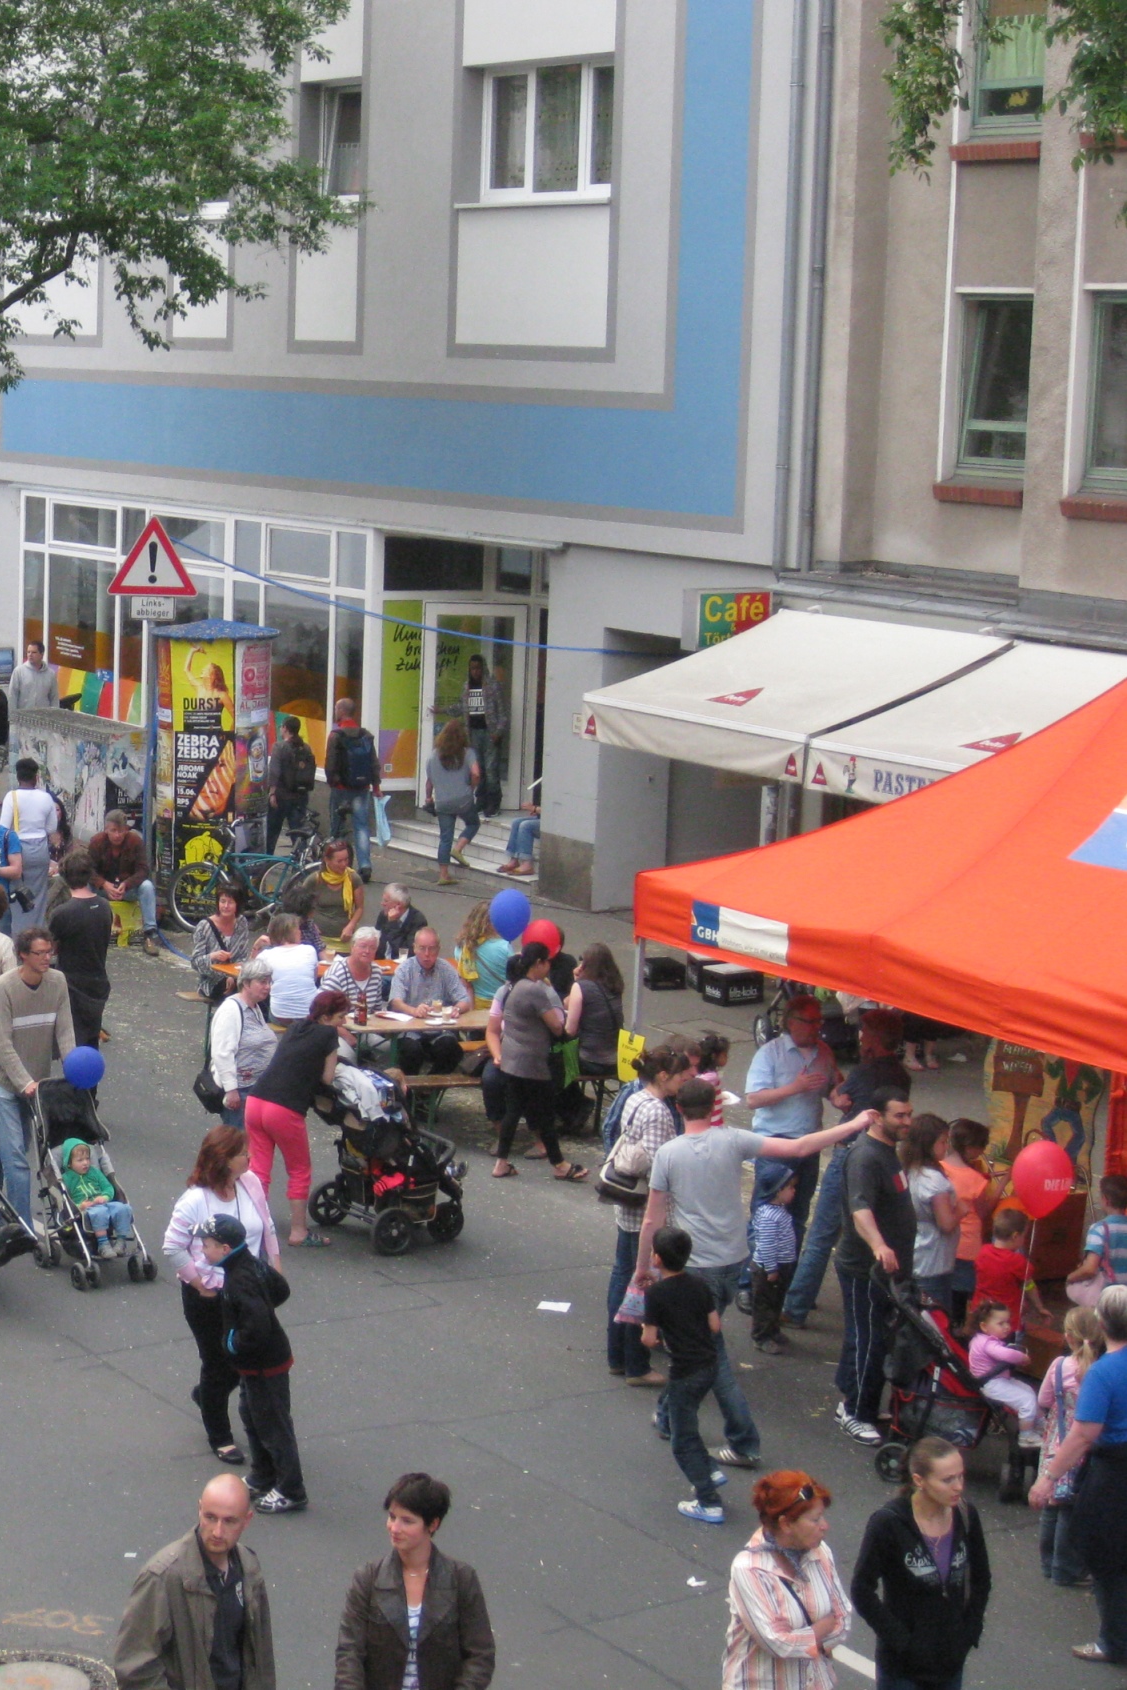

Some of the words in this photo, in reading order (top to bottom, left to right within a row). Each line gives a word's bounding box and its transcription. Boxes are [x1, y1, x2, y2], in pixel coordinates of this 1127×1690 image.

[141, 599, 165, 607] Links-
[704, 594, 765, 622] Café
[136, 608, 170, 617] abbieger
[183, 697, 221, 710] DURST
[177, 733, 220, 747] ZEBRA
[177, 746, 218, 760] ZEBRA
[177, 764, 205, 772] JEROME
[177, 771, 198, 779] NOAK
[873, 769, 935, 795] PASTE
[697, 926, 720, 941] GBH
